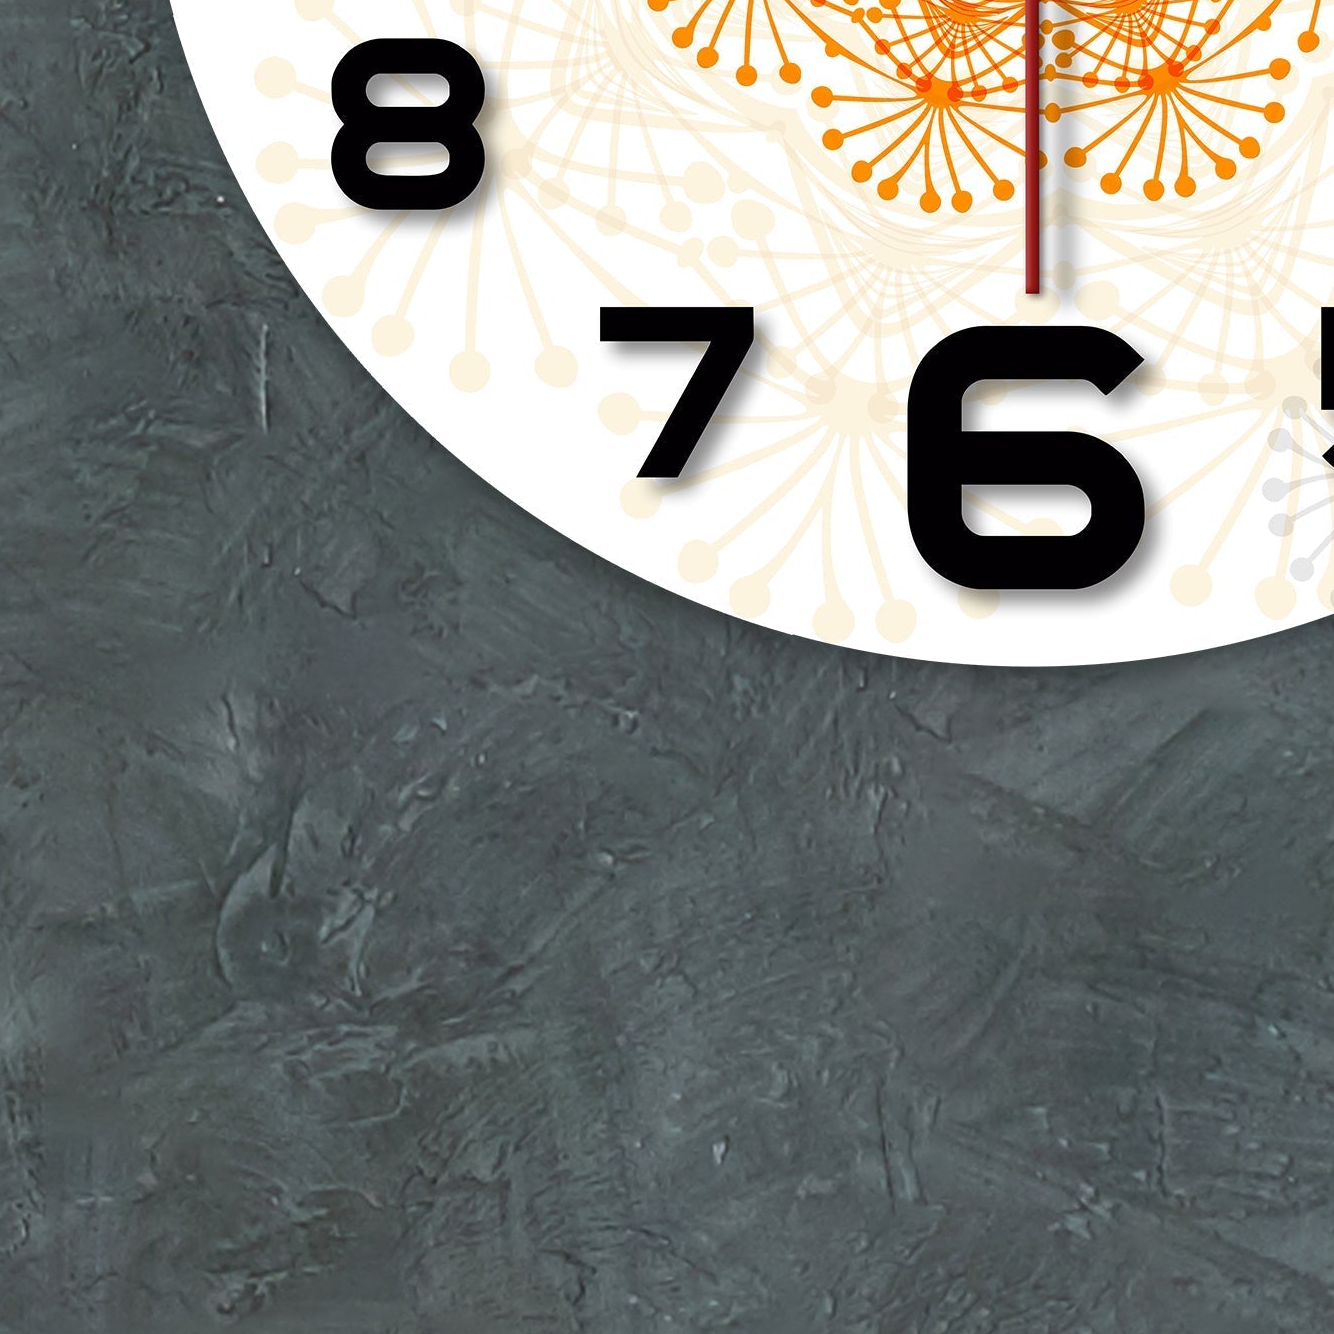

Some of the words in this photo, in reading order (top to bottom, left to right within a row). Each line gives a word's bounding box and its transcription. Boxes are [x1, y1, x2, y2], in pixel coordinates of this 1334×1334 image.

[331, 38, 486, 211] 8
[599, 307, 755, 478] 7
[907, 326, 1146, 590] 6
